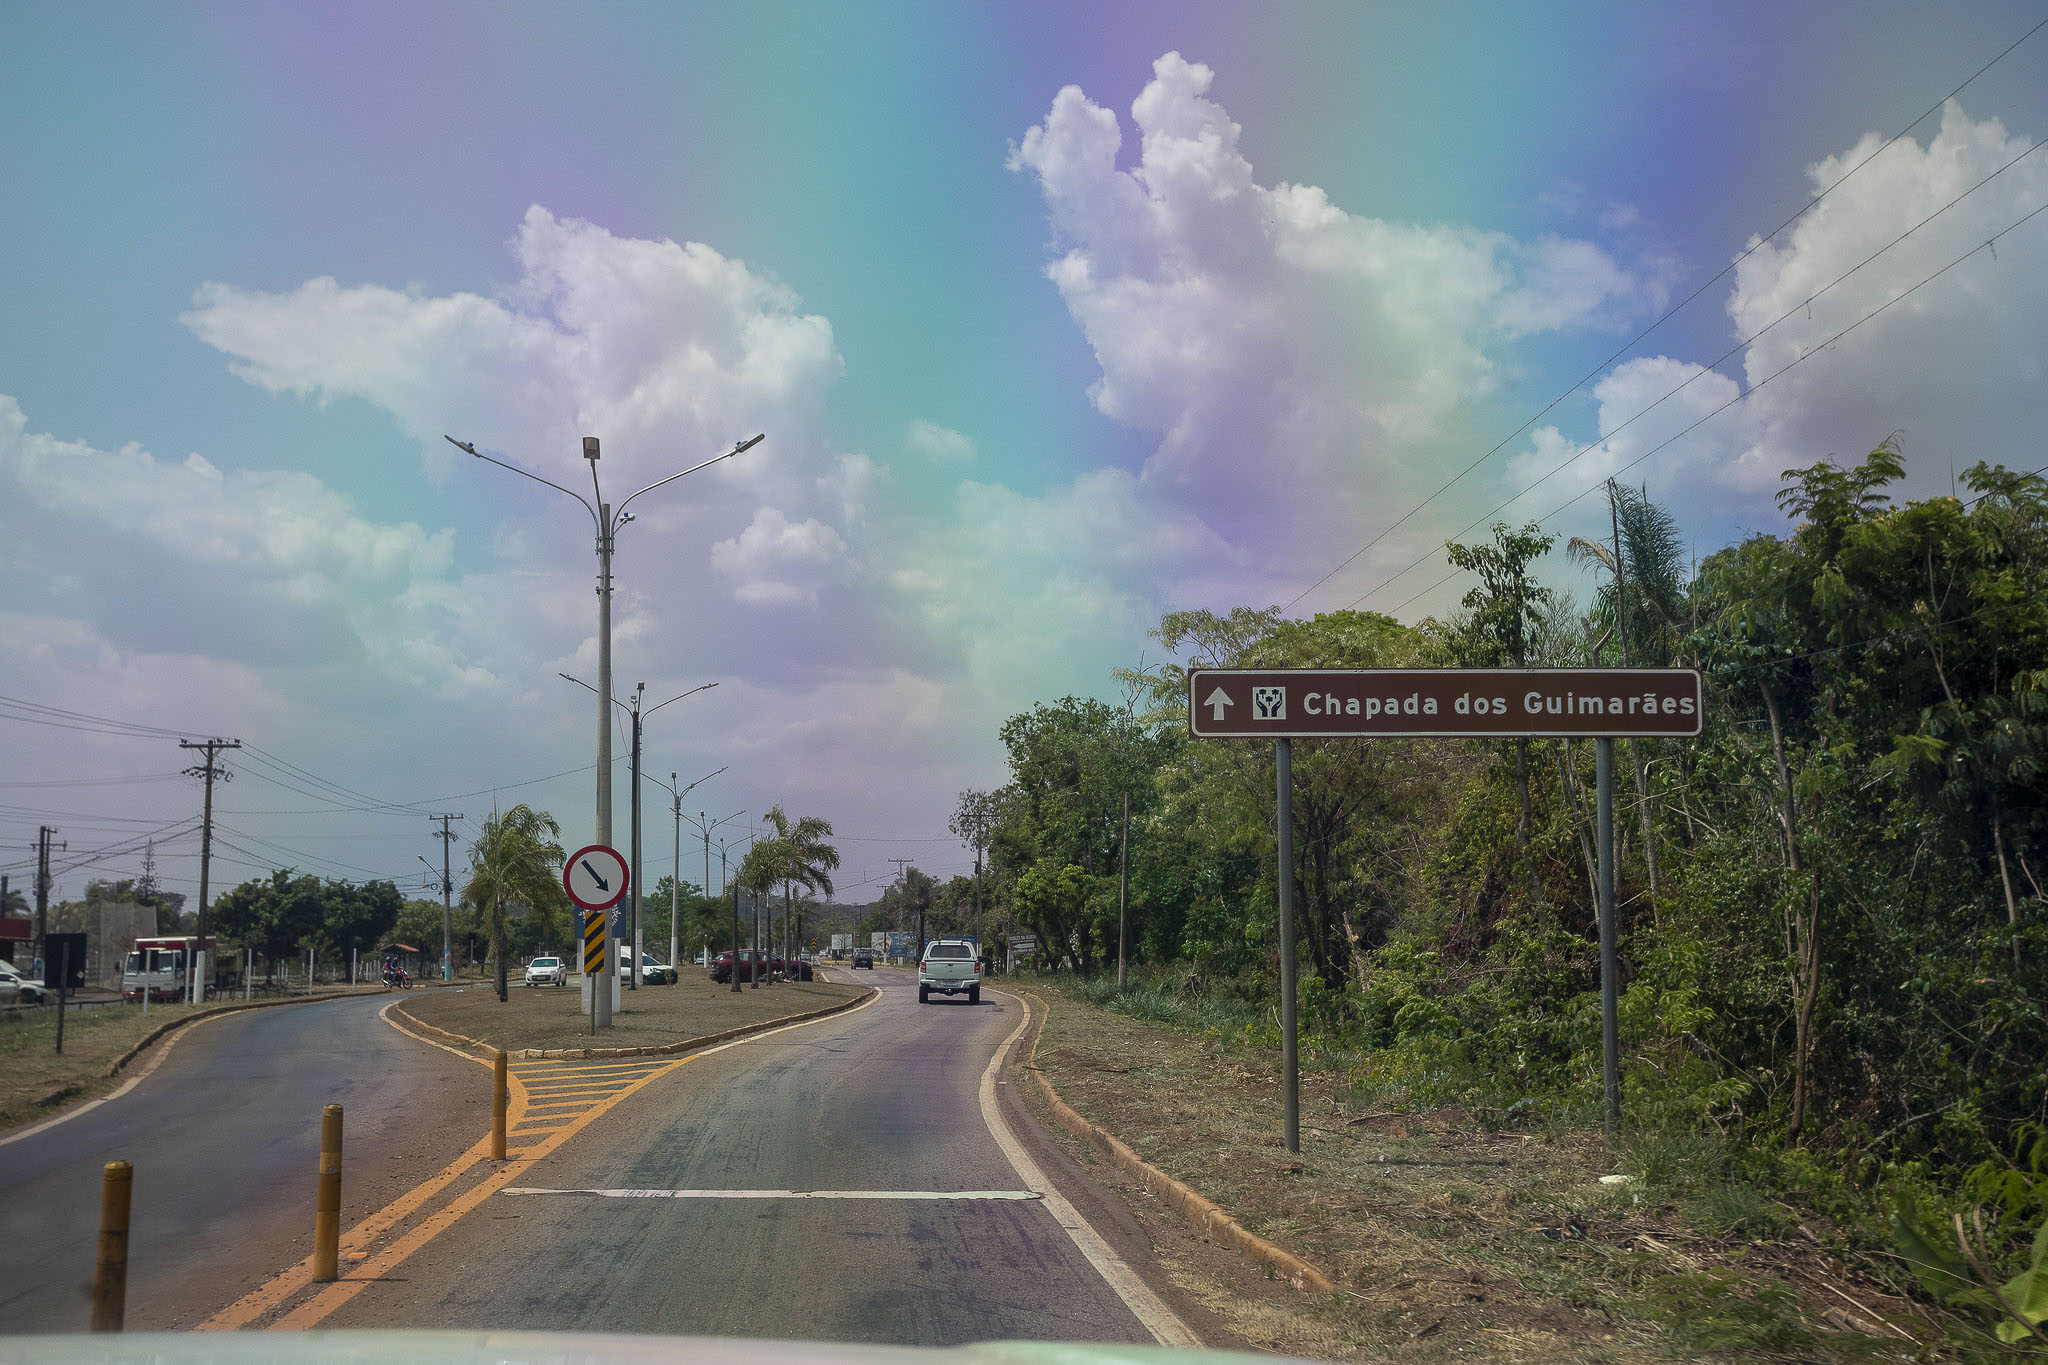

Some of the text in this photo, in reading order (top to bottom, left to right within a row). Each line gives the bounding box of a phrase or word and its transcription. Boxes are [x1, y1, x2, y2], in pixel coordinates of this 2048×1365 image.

[1303, 691, 1695, 720] Chapada dos Guimarães
